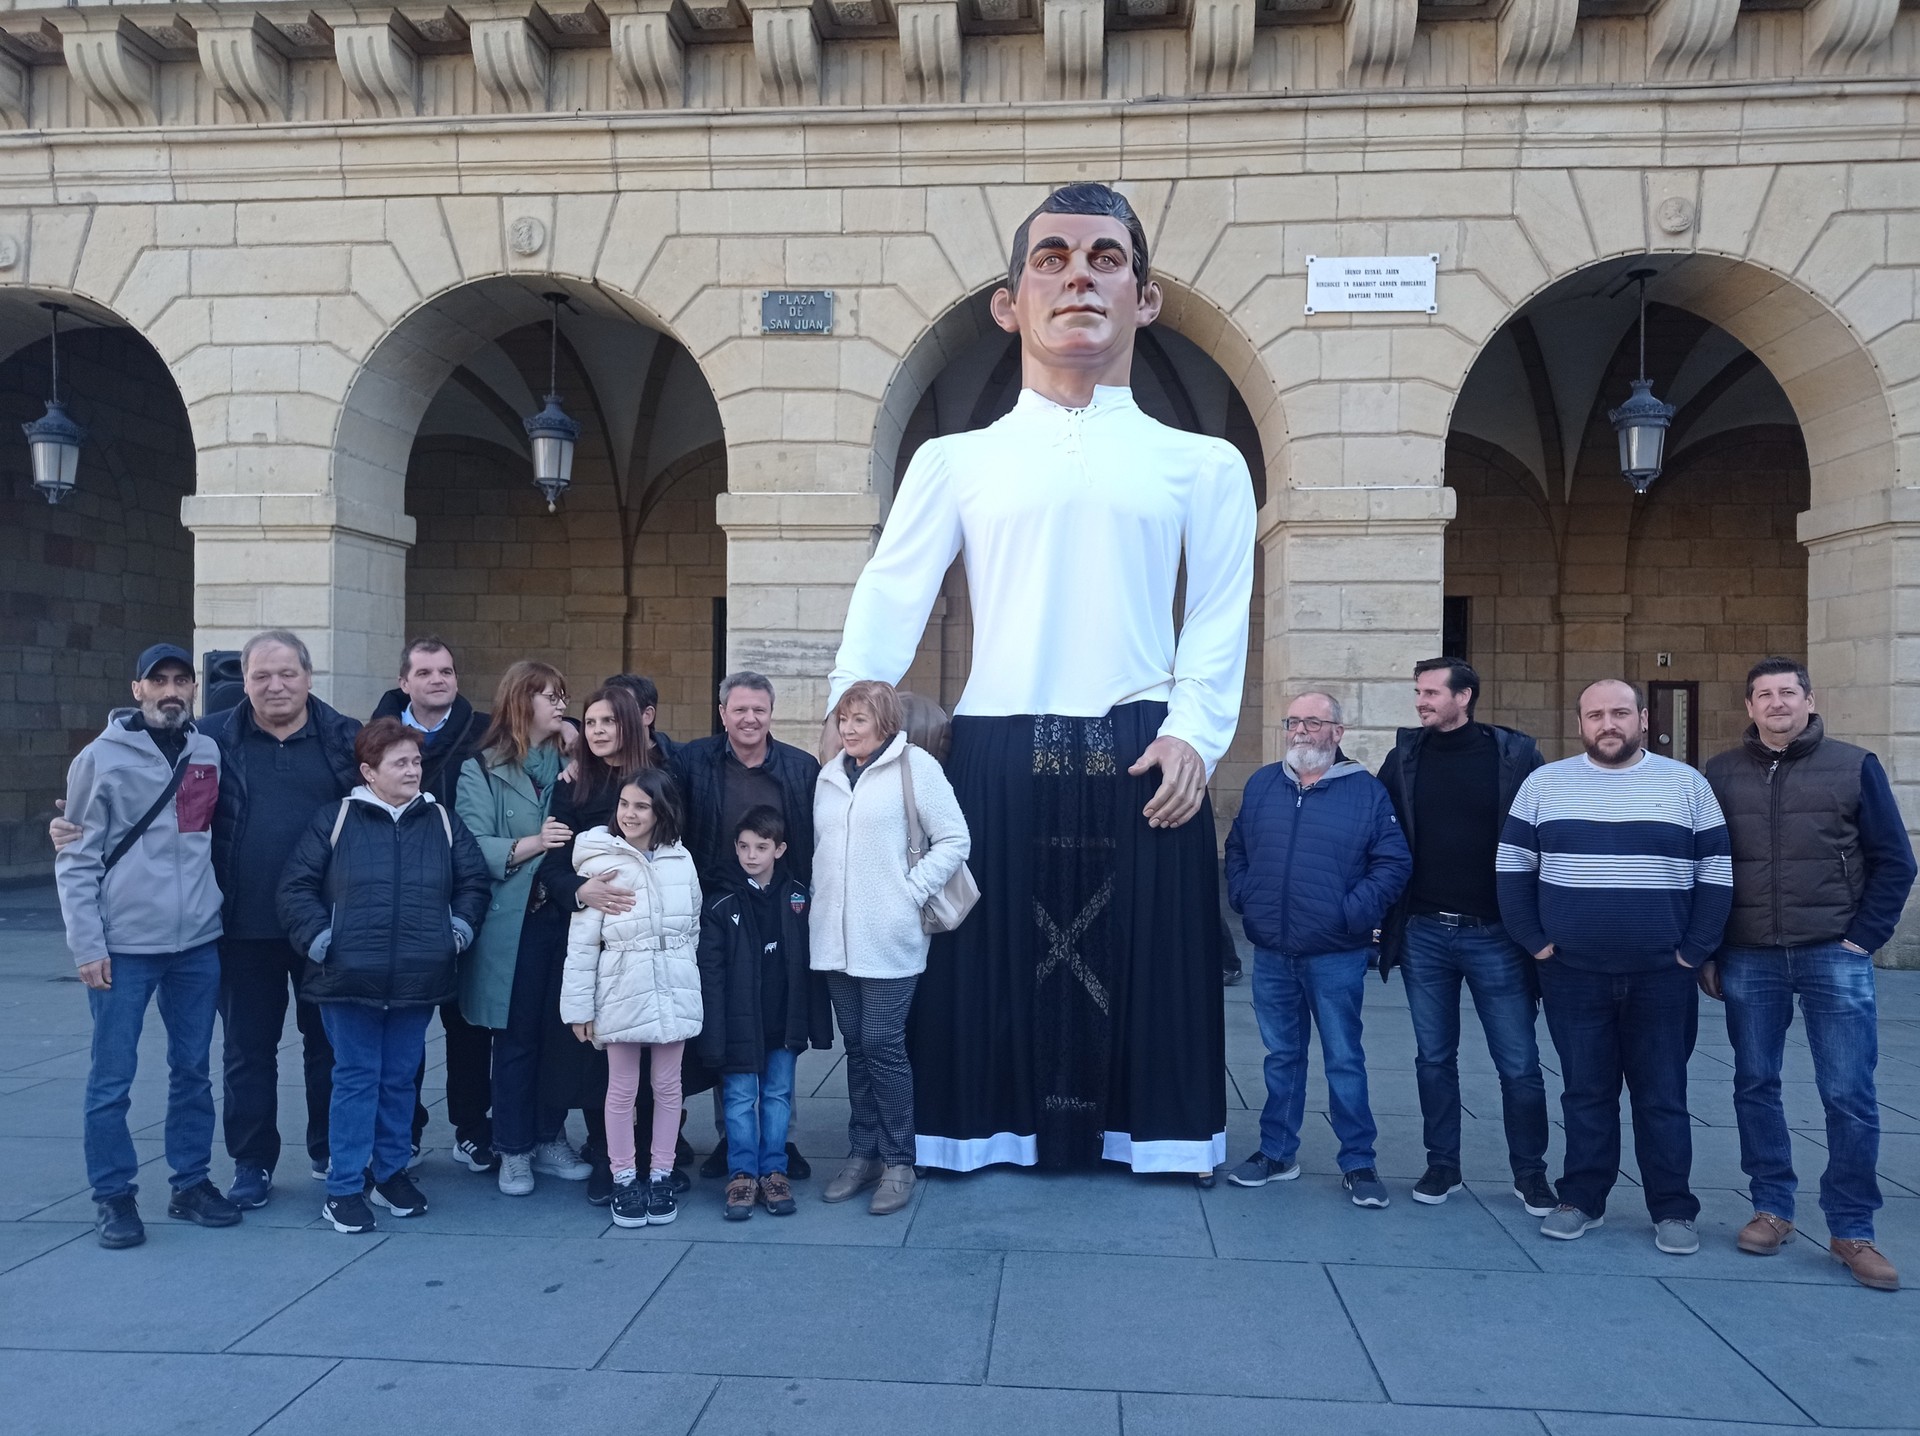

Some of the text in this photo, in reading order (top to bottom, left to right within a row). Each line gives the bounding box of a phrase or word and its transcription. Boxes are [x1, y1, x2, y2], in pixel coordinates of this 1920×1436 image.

[778, 295, 815, 305] PLAZA
[789, 306, 803, 317] DE
[770, 318, 823, 330] SAN JUAN
